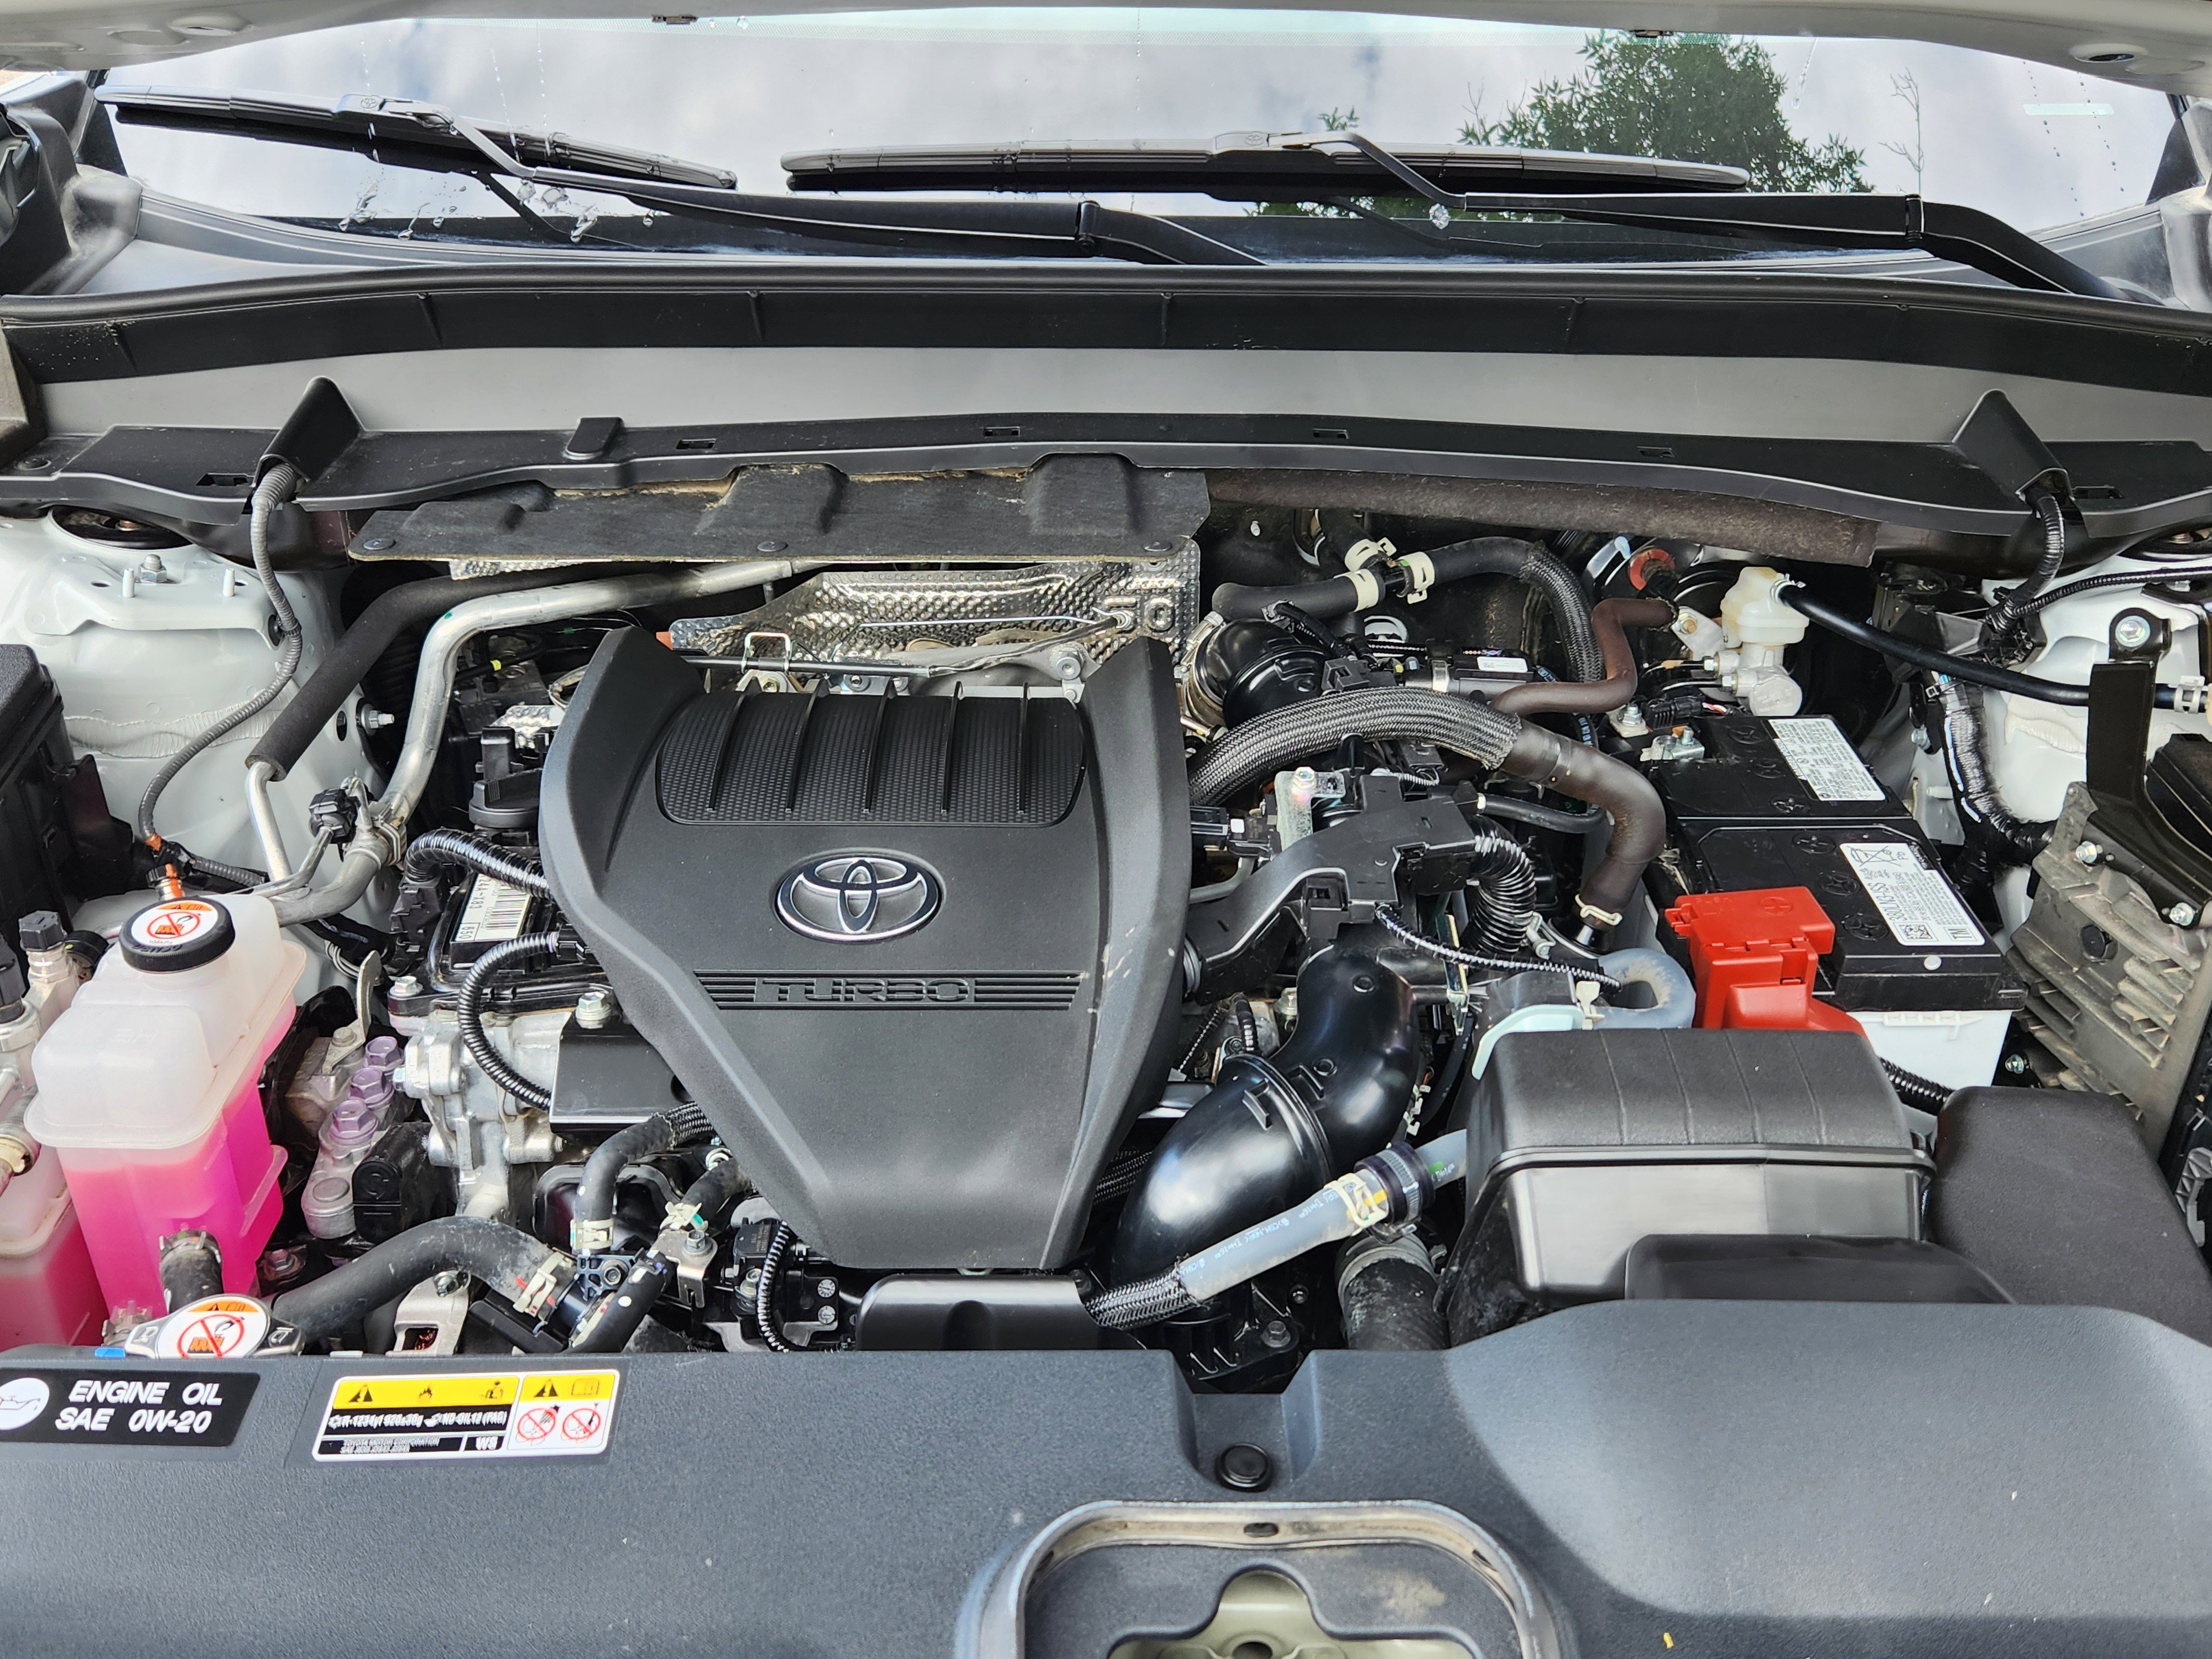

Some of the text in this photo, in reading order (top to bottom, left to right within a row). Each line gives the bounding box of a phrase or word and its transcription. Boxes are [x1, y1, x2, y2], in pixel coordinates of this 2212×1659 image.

[1947, 928, 1973, 940] TM
[763, 978, 969, 1003] TURBO
[69, 1380, 222, 1406] ENGINE OIL
[55, 1407, 212, 1434] SAE 0W-20
